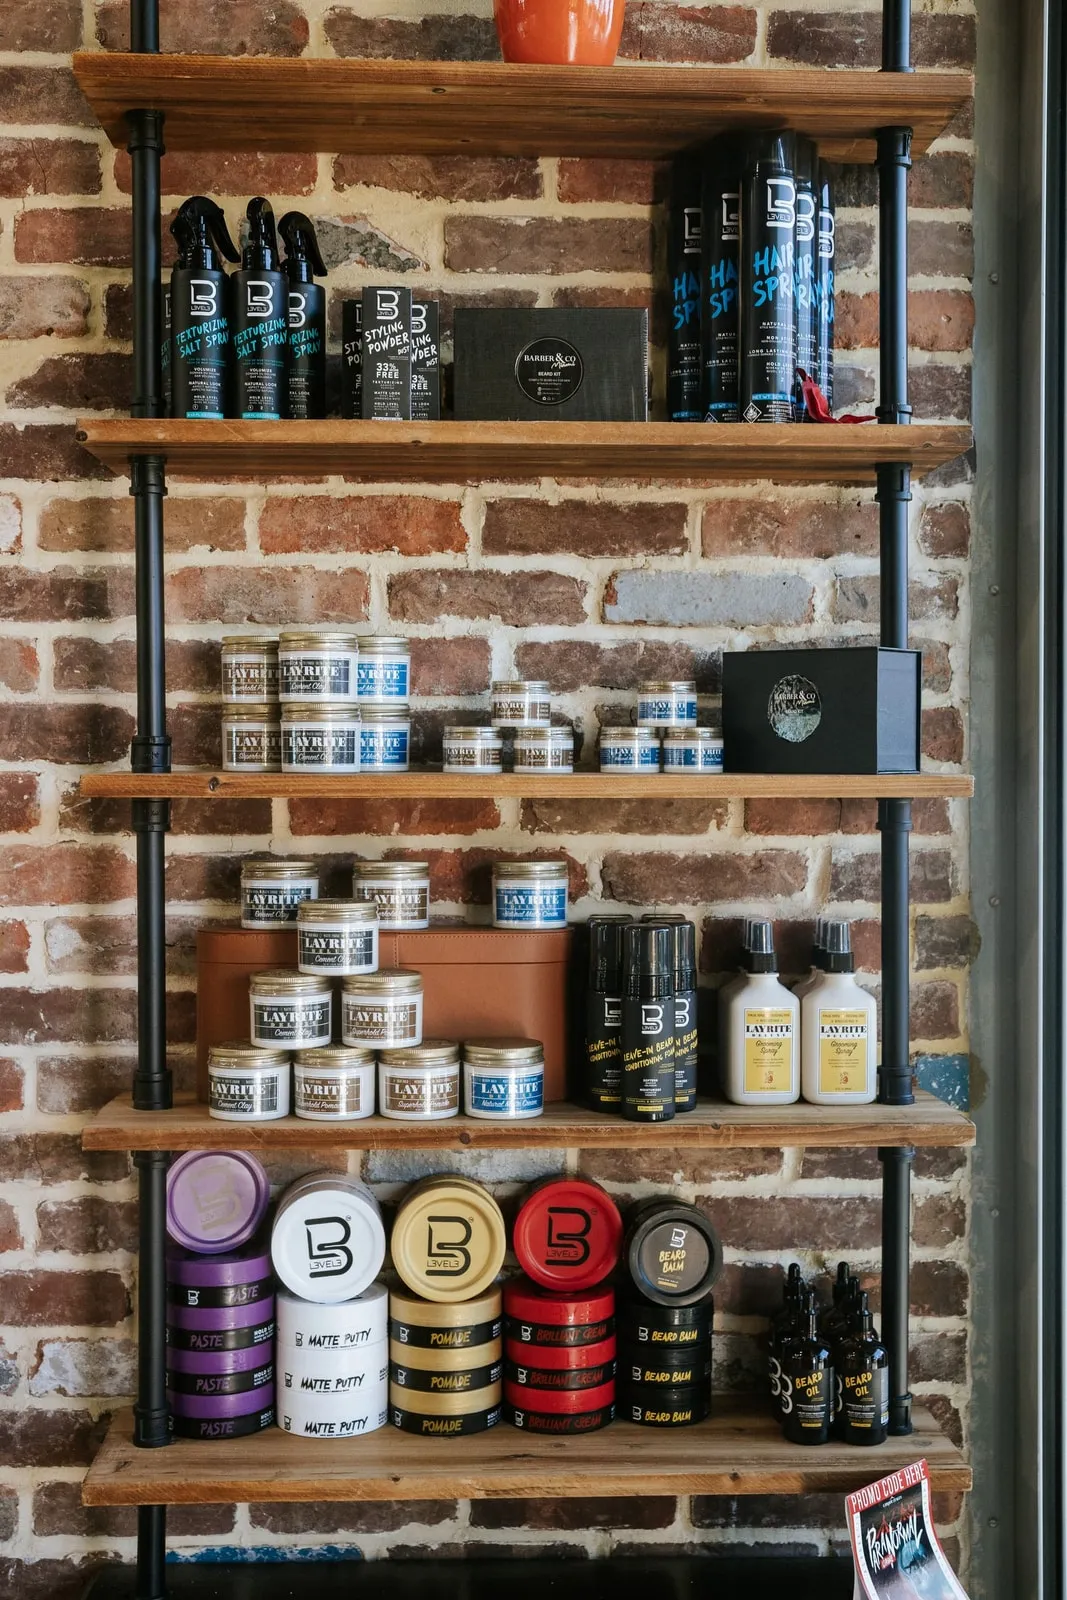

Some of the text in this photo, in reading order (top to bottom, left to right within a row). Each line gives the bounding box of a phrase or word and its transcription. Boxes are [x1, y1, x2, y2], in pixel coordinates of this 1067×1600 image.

[753, 241, 796, 276] HAIR
[710, 258, 738, 289] HA
[175, 317, 228, 346] TEXTURIZING
[233, 318, 286, 347] TEXTURIZING
[364, 320, 404, 342] STYLING
[179, 339, 202, 359] SALT
[205, 330, 230, 348] SPRAY
[236, 330, 288, 360] SALT SPRAY
[367, 331, 410, 354] POWDER
[376, 371, 400, 379] FREE
[503, 895, 559, 905] LAYRITE
[305, 937, 364, 949] LAYRITE
[263, 1010, 323, 1022] LAYRITE
[349, 1010, 409, 1022] LAYRITE
[746, 1025, 792, 1033] LAYRITE
[820, 1025, 868, 1034] LAYRITE
[755, 1039, 783, 1050] Grooming
[759, 1046, 778, 1057] Spray
[830, 1040, 858, 1051] Grooming
[623, 1045, 654, 1062] LEAVE-IN
[834, 1047, 854, 1057] Spray
[211, 1081, 266, 1095] LAYRITE
[393, 1082, 453, 1095] LAYRITE
[481, 1081, 538, 1094] LAYRITE
[658, 1249, 687, 1263] BEARD
[662, 1261, 685, 1274] BALM
[308, 1327, 372, 1348] MATTE PUTTY
[430, 1331, 472, 1345] POMADE
[536, 1324, 608, 1342] BRILLIANT CREAM
[651, 1329, 698, 1342] BEARD BALM
[190, 1334, 224, 1348] PASTE
[301, 1376, 332, 1391] MATTE
[335, 1373, 365, 1390] PUTTY
[430, 1374, 472, 1389] POMADE
[644, 1370, 692, 1383] BEARD BALM
[795, 1371, 823, 1389] BEARD
[844, 1371, 873, 1388] BEARD
[195, 1377, 232, 1392] PASTE
[806, 1385, 820, 1398] OIL
[855, 1385, 870, 1397] OIL
[527, 1413, 602, 1430] BRILLIANT CREAM
[644, 1409, 692, 1423] BEARD BALM
[200, 1421, 235, 1436] PASTE
[304, 1416, 369, 1435] MATTE PUTTY
[422, 1419, 463, 1433] POMADE
[850, 1483, 881, 1513] PROMO
[881, 1472, 905, 1497] CODE
[903, 1462, 926, 1487] HERE
